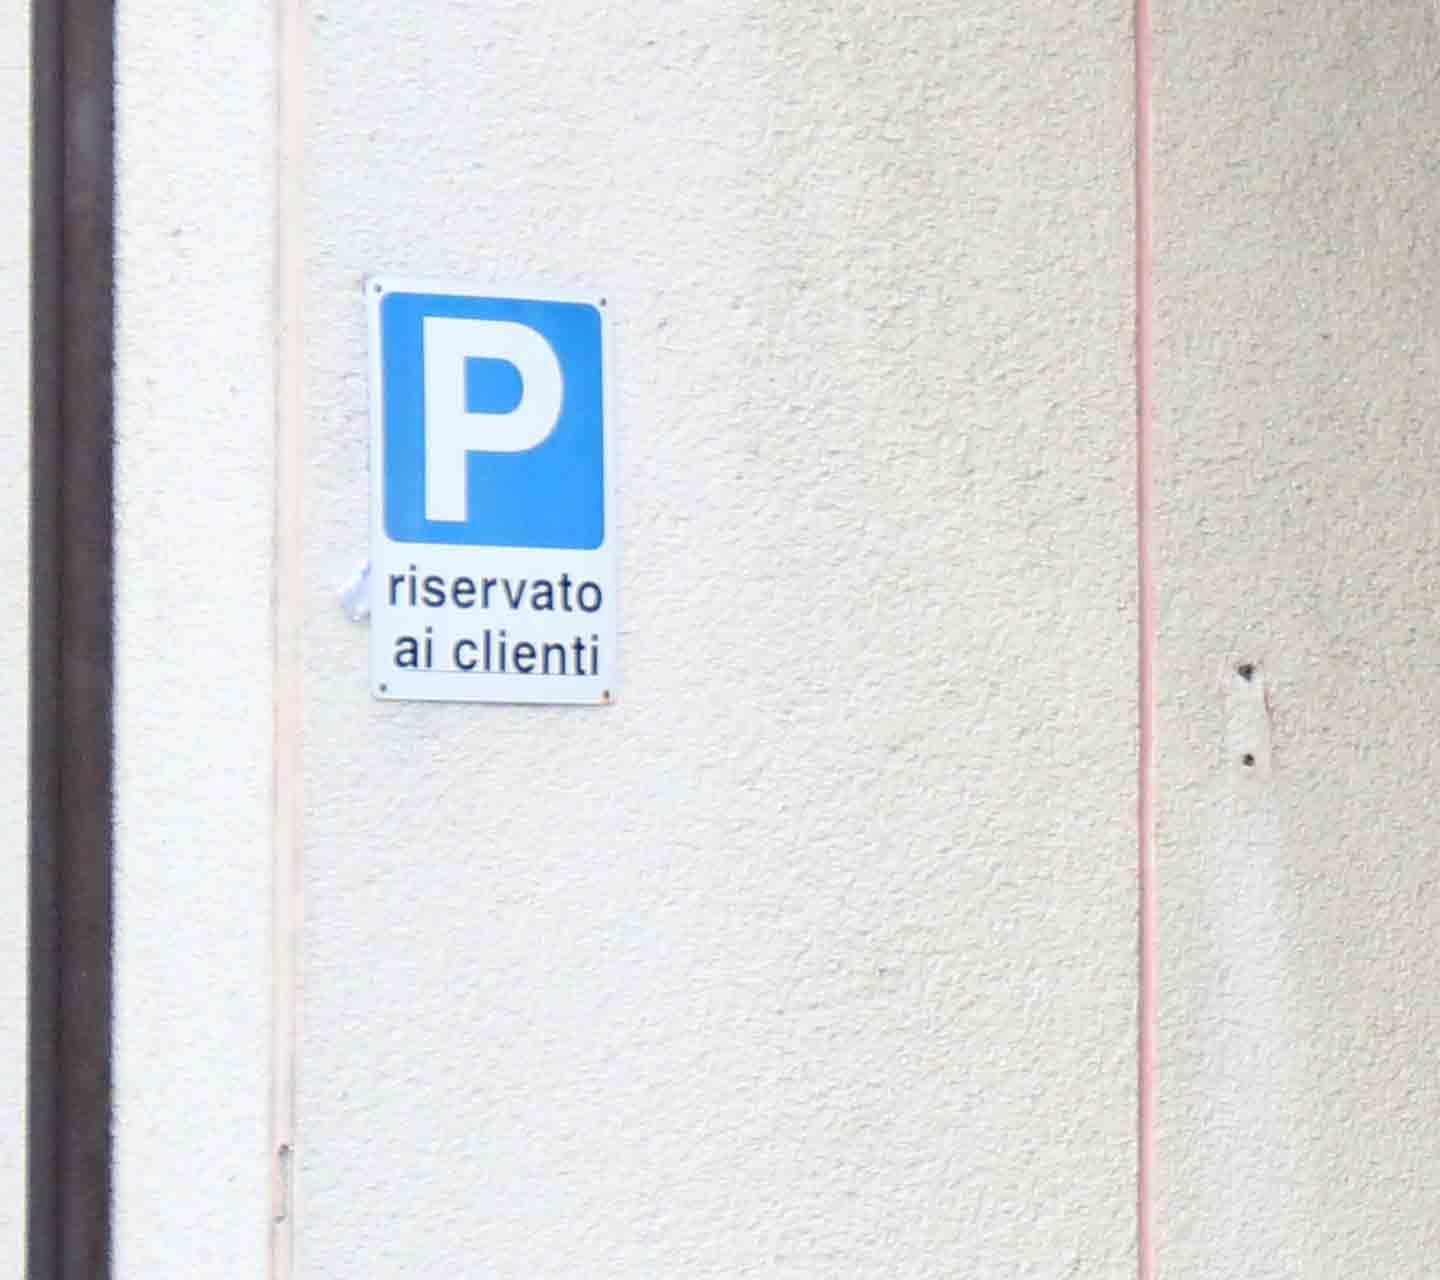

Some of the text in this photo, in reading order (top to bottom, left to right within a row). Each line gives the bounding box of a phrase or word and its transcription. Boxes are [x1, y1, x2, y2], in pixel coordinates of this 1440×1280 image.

[423, 316, 564, 523] P
[388, 564, 602, 613] riservato
[394, 626, 600, 676] ai clienti
